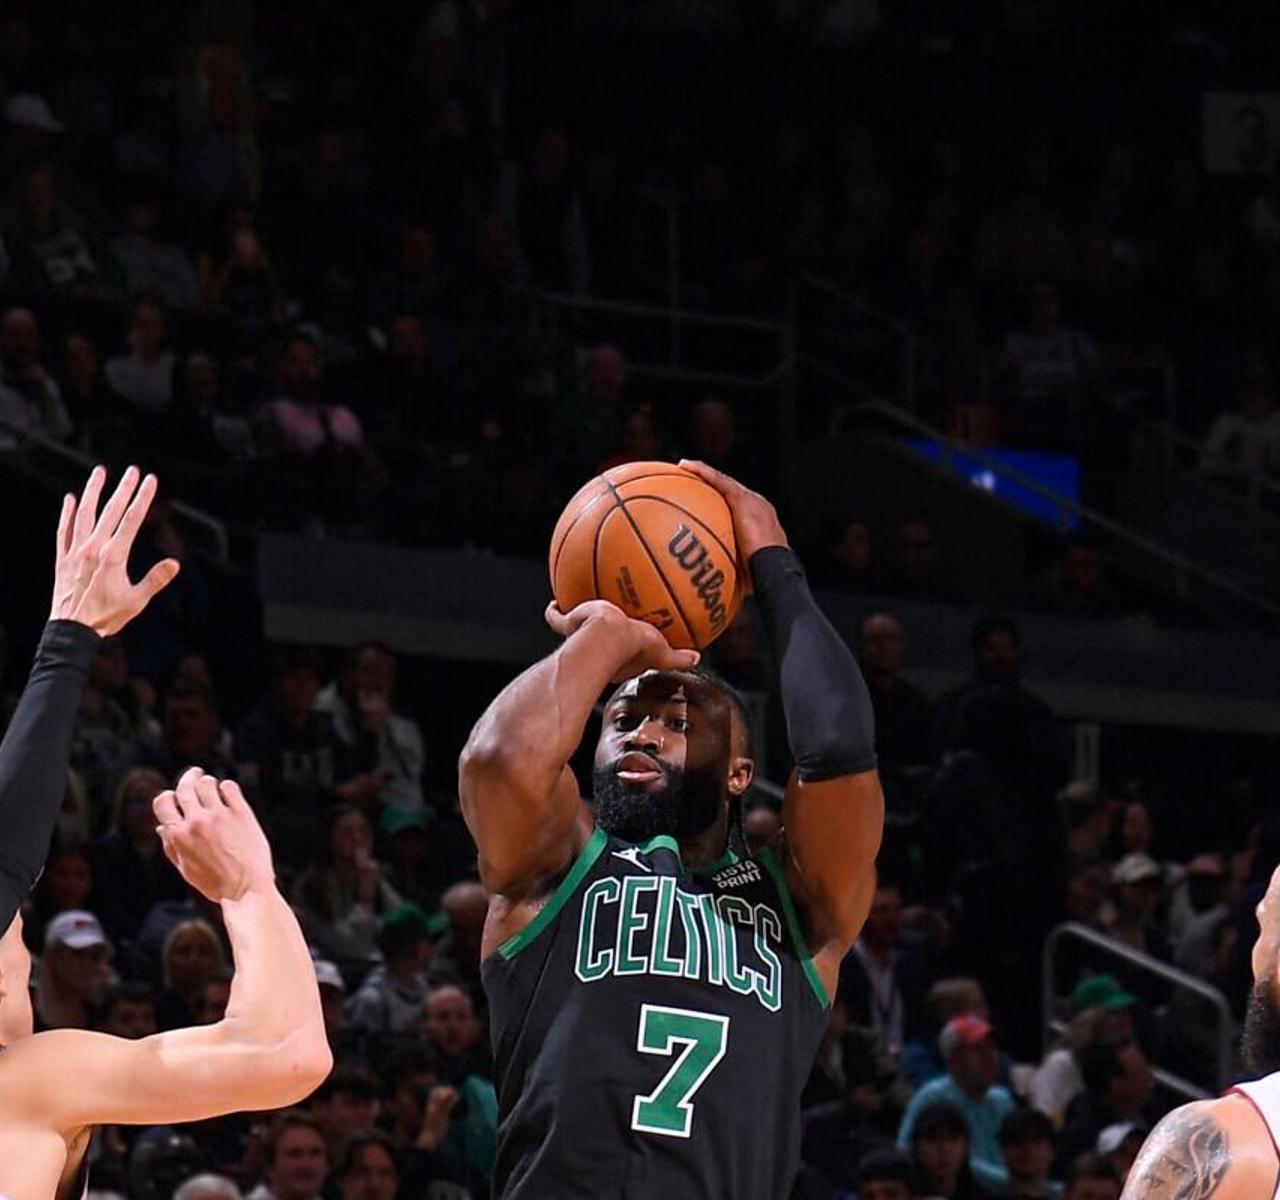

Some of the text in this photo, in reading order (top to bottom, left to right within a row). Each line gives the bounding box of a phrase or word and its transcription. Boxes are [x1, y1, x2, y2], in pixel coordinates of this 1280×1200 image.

[711, 860, 758, 882] VISTA
[717, 868, 762, 889] PRINT
[574, 875, 783, 1013] CELTICS
[631, 1003, 731, 1138] 7
